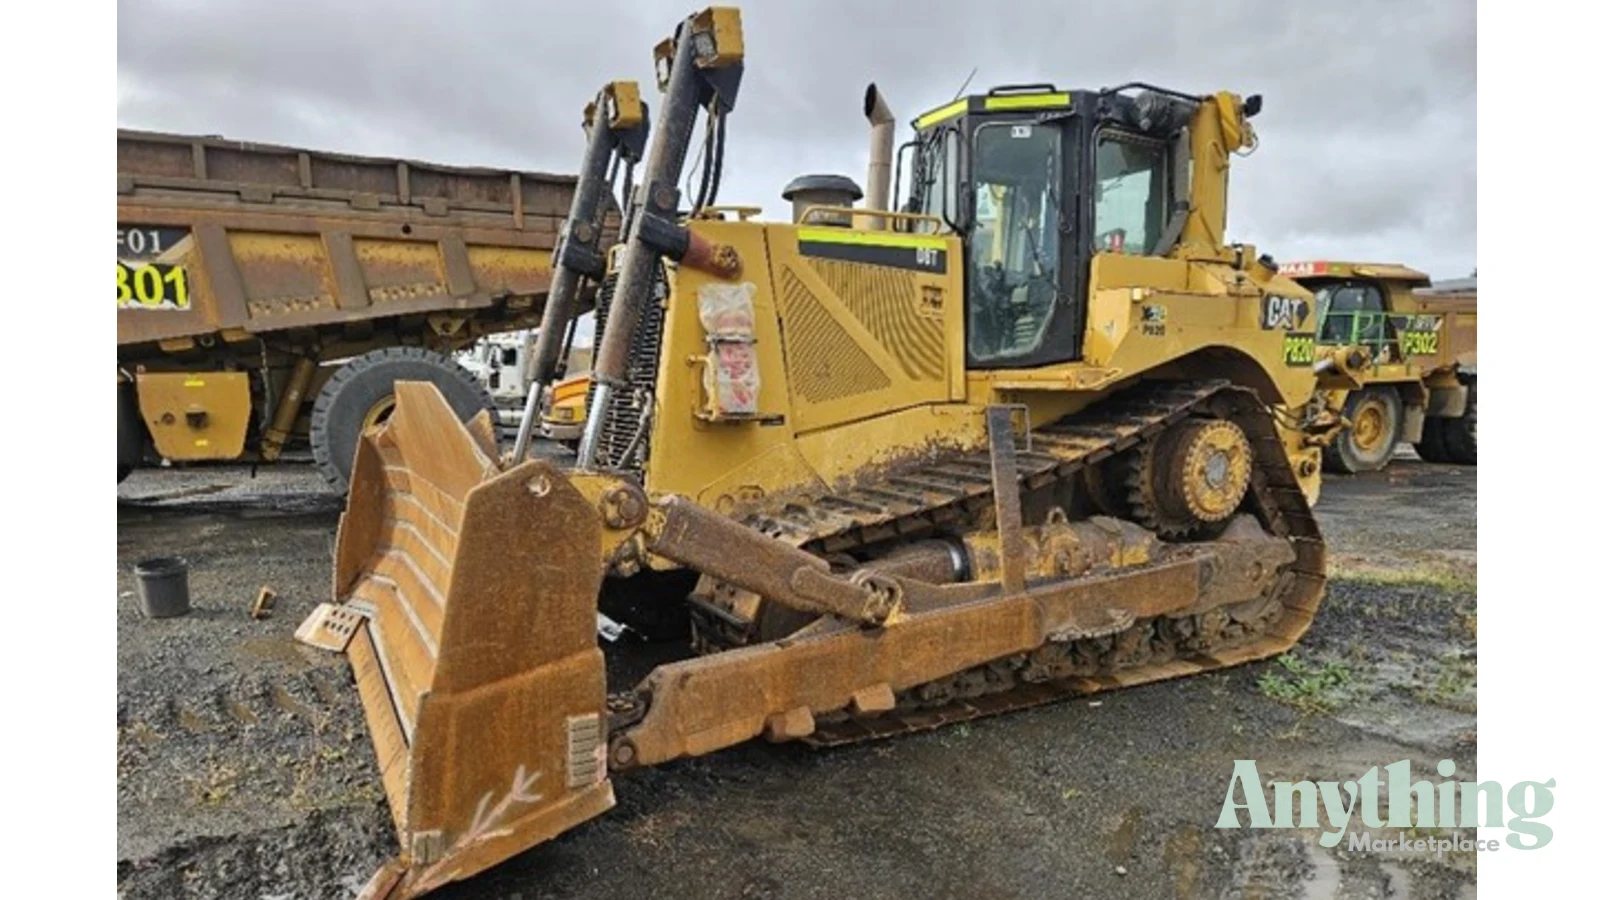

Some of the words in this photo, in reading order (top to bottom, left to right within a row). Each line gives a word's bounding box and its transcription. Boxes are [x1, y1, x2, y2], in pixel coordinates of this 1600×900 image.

[1268, 296, 1303, 328] CAT
[1284, 337, 1313, 362] P820
[1404, 332, 1438, 354] P302
